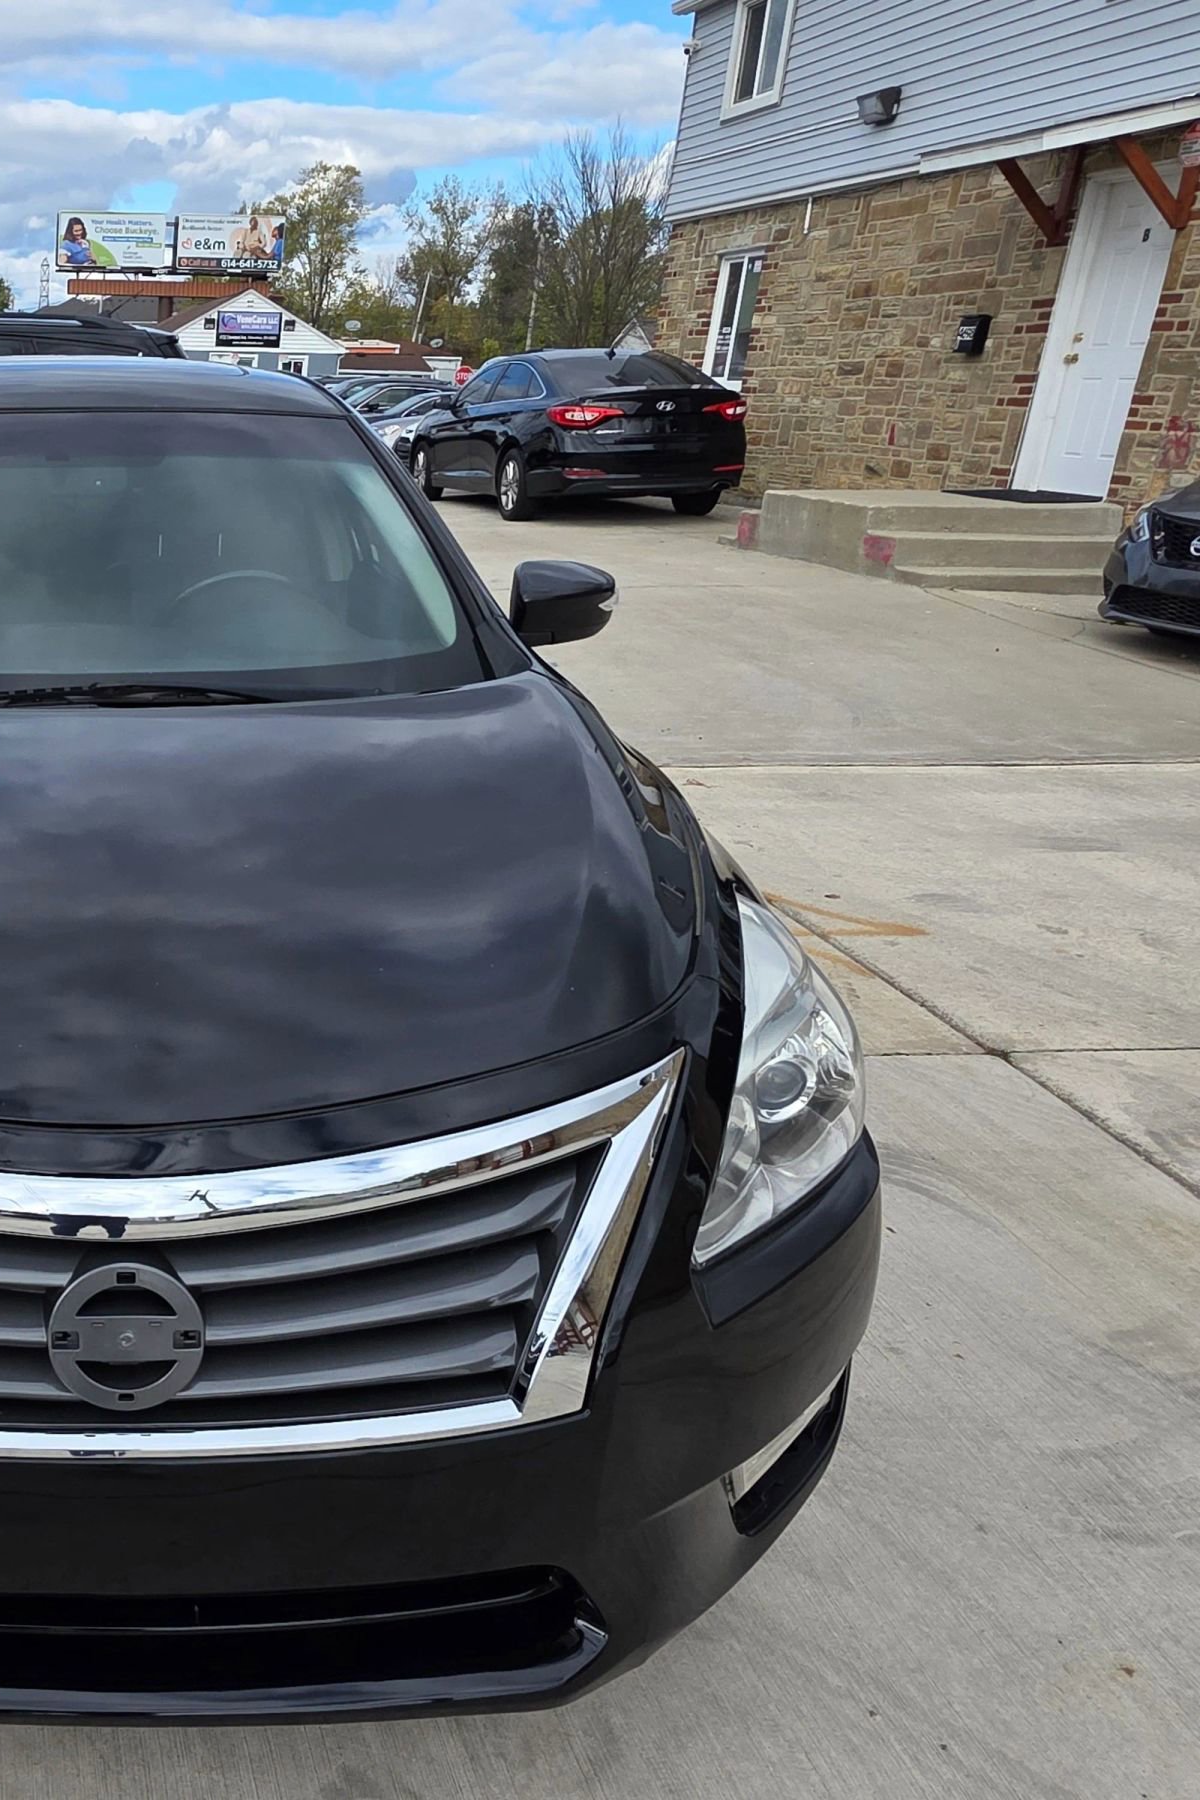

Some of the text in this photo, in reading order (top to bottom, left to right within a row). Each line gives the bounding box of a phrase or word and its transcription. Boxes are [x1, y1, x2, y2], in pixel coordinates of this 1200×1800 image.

[94, 226, 123, 234] Choose
[1142, 228, 1151, 242] B
[194, 237, 226, 250] e&m
